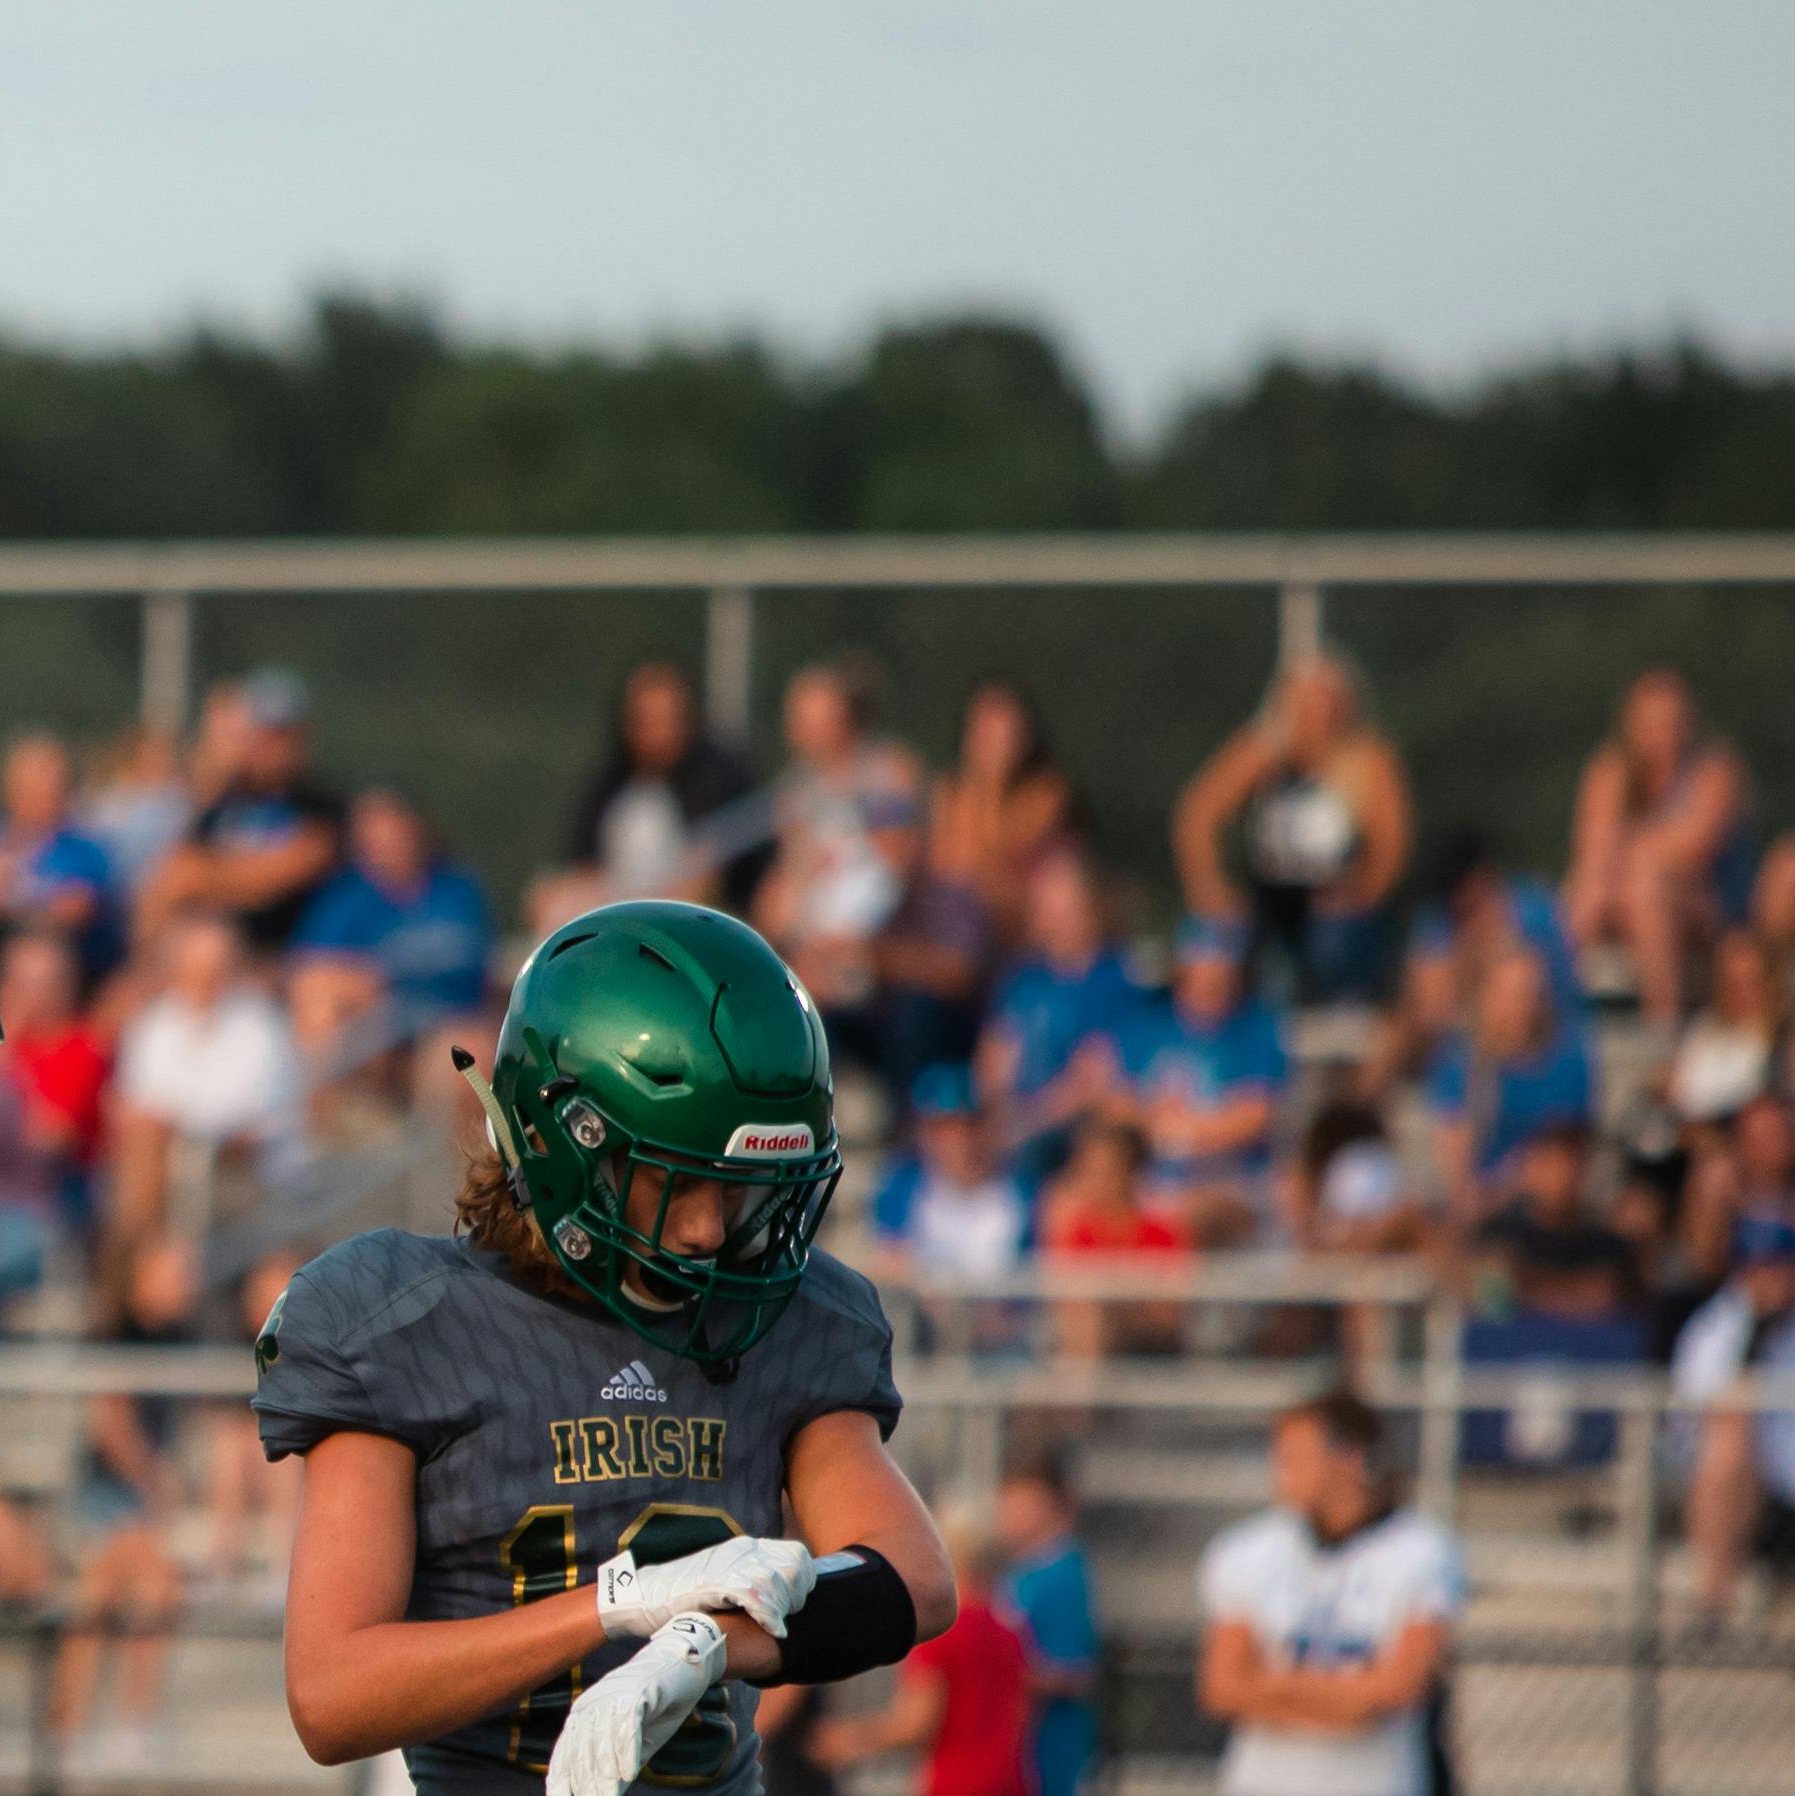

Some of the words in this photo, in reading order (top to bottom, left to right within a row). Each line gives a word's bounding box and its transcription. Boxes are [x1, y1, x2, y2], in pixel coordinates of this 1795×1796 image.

[744, 1135, 809, 1151] Riddell
[600, 1383, 667, 1402] adidas
[550, 1415, 727, 1484] IRISH
